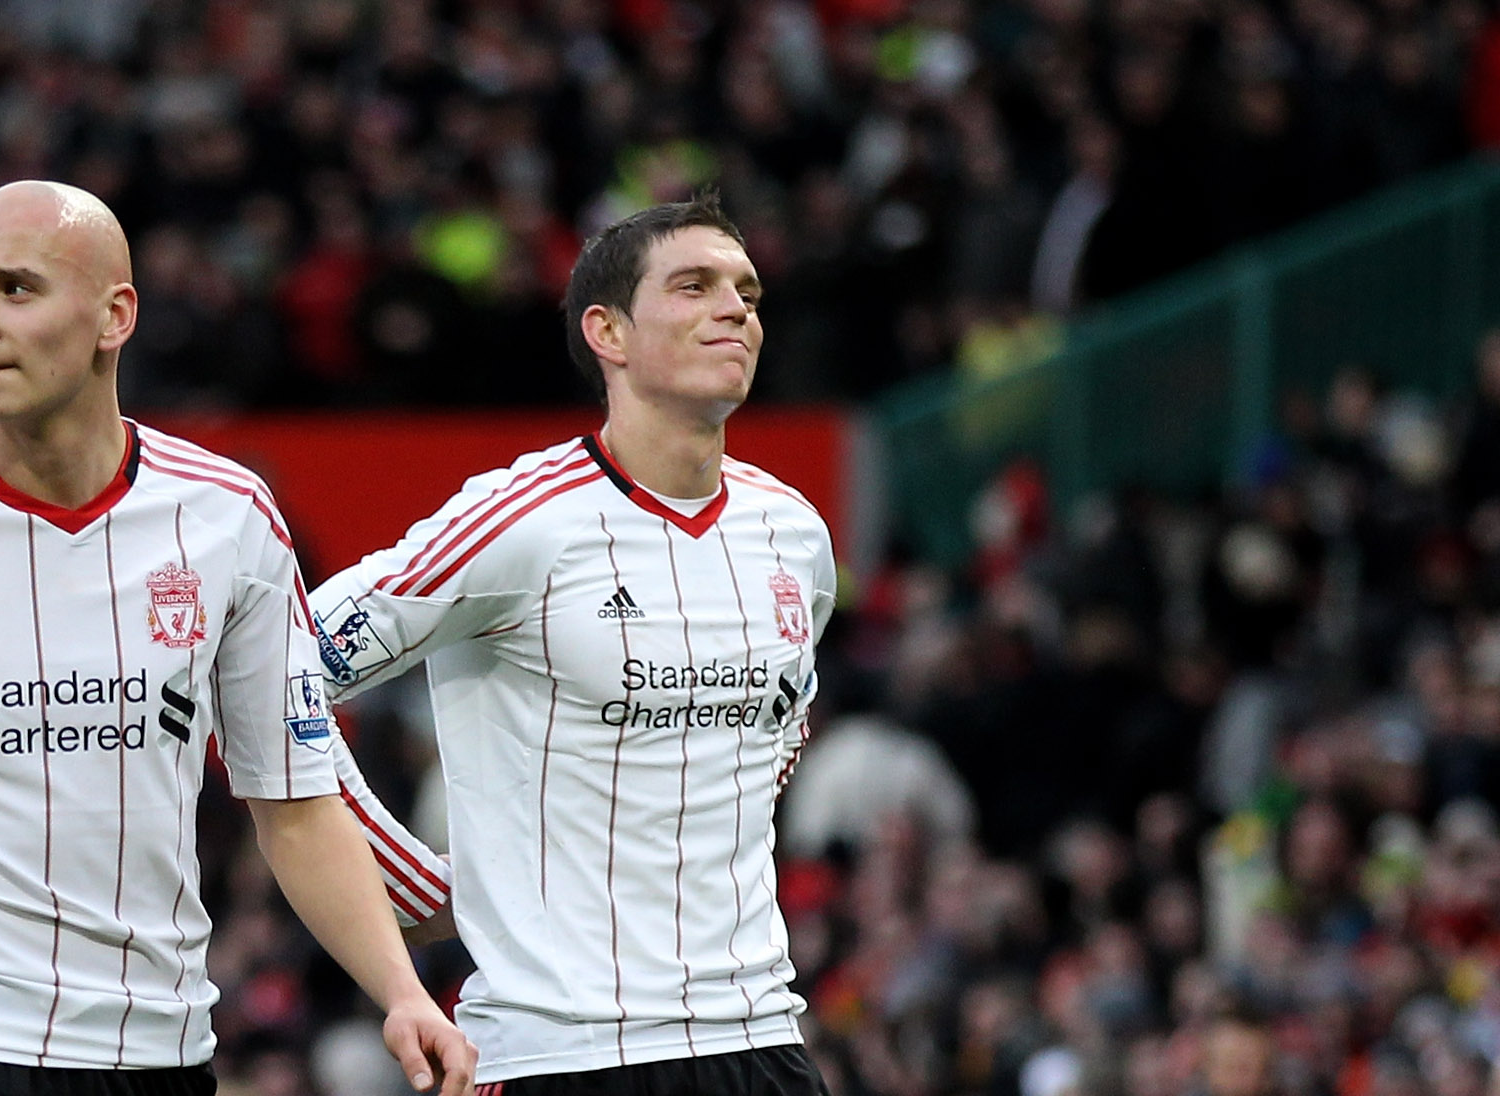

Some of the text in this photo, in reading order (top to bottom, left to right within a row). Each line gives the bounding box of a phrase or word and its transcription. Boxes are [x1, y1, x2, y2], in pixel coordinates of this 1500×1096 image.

[154, 592, 196, 603] LIVERPOOL
[597, 606, 646, 620] adidas
[621, 658, 768, 691] Standard
[601, 698, 764, 729] Chartered
